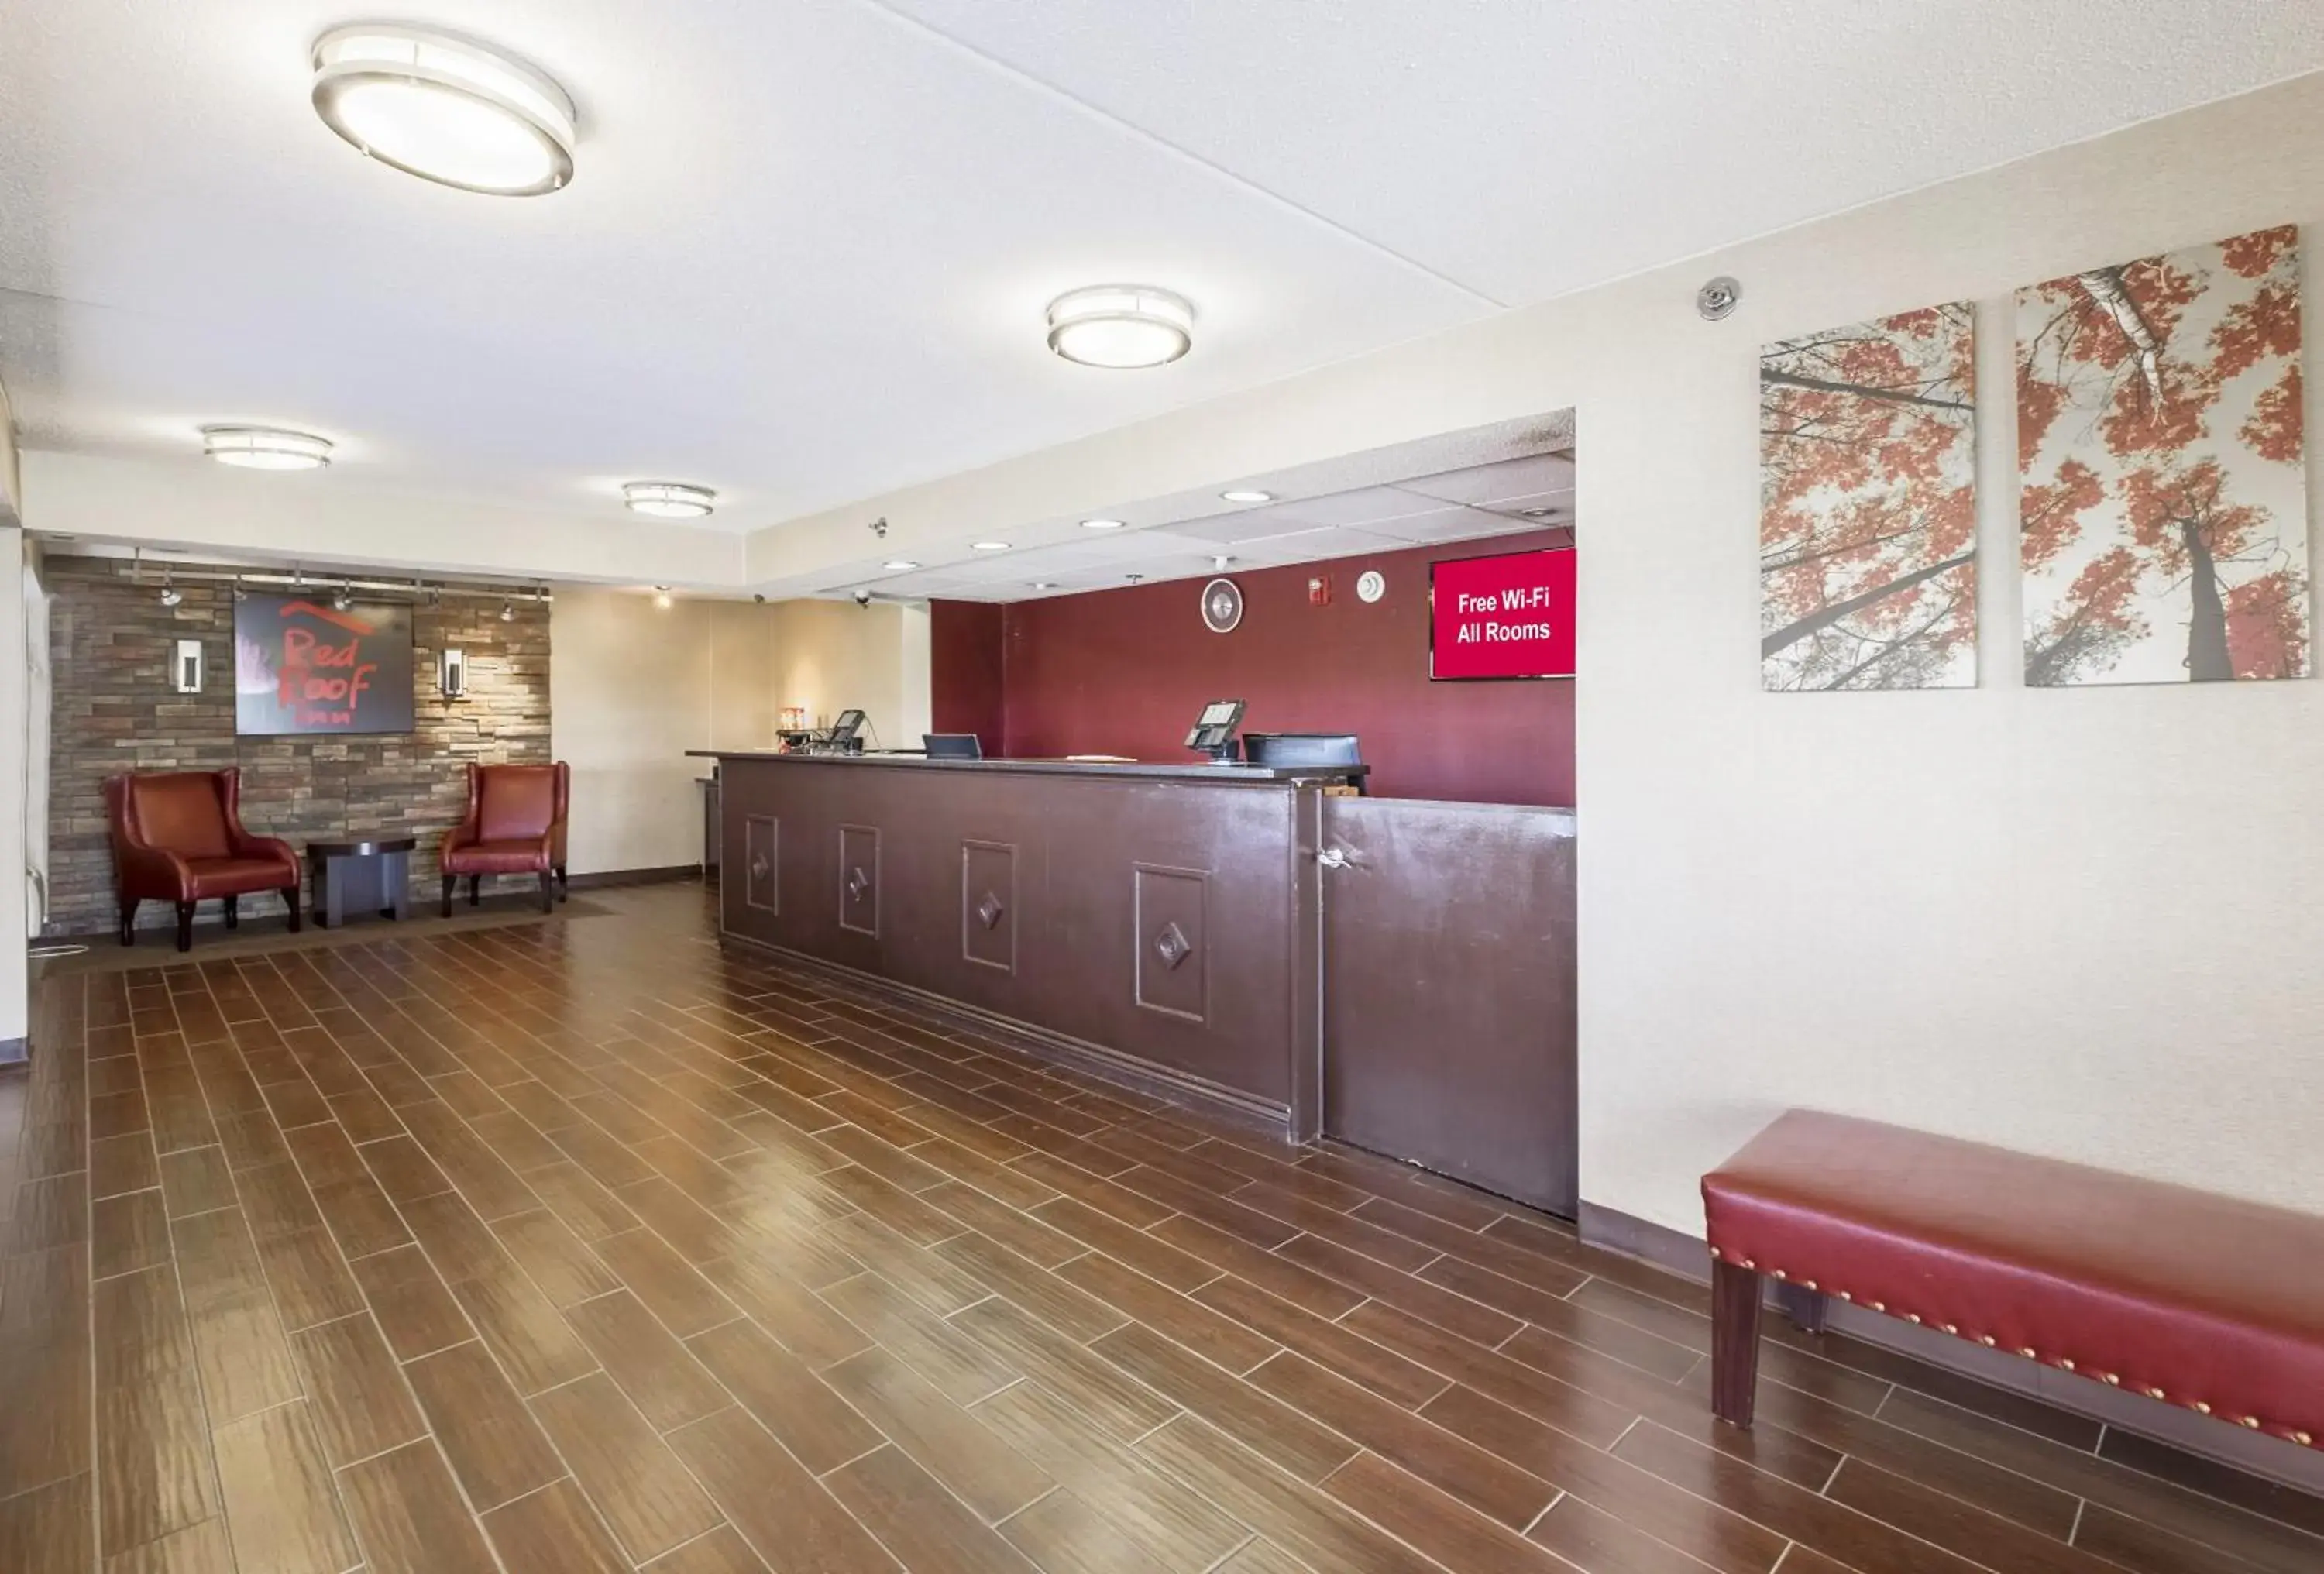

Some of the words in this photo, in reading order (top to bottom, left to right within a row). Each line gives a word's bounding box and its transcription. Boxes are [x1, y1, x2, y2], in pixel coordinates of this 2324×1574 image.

[1459, 593, 1497, 613] Free
[1501, 586, 1550, 610] Wi-Fi
[1457, 623, 1480, 644] All
[1486, 622, 1551, 642] Rooms
[284, 627, 359, 667] Red
